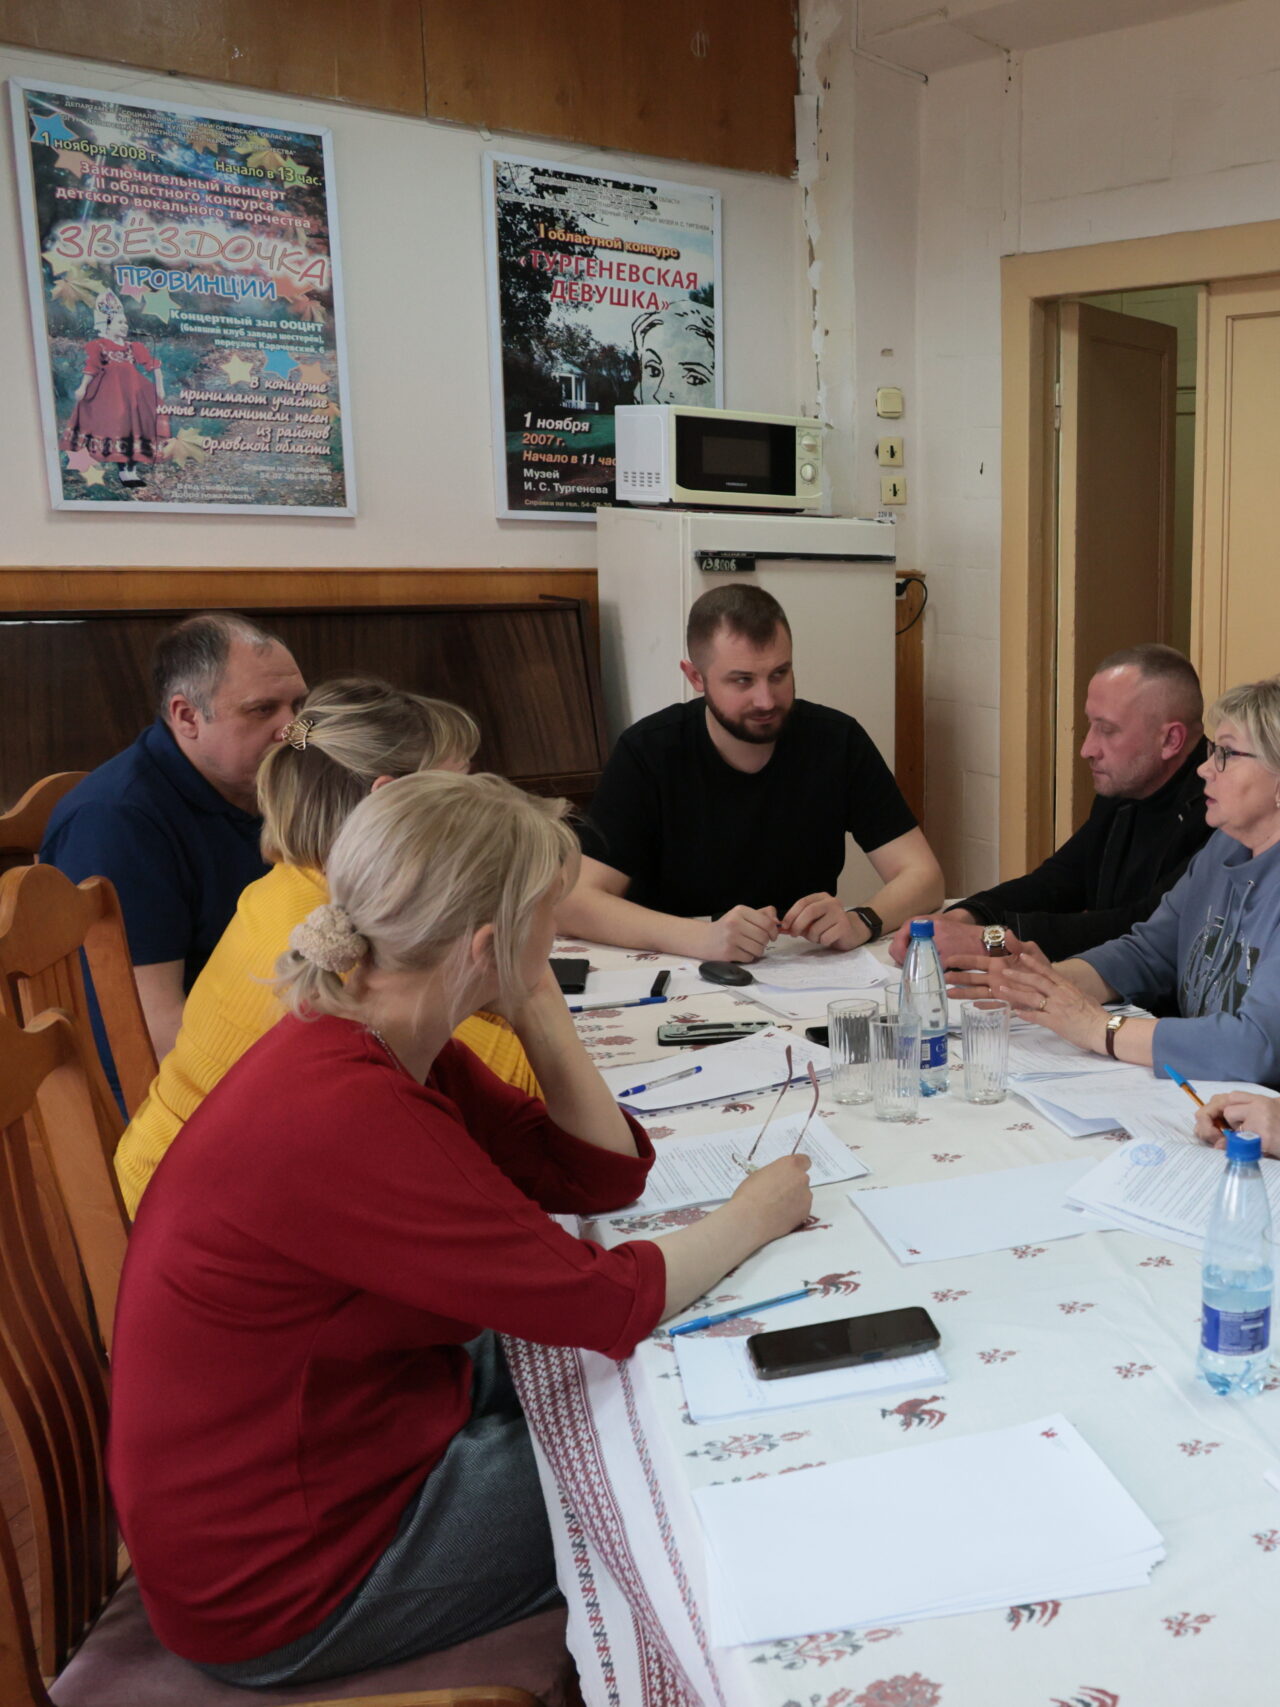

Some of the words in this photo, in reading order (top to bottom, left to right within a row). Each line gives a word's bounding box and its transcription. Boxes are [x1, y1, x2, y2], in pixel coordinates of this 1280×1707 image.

[41, 132, 50, 147] 1
[54, 139, 107, 156] ноября
[110, 143, 147, 161] 2008
[151, 152, 161, 163] г.
[81, 161, 220, 192] Заключительный
[224, 183, 287, 201] концерт
[216, 160, 264, 178] Начало
[267, 170, 275, 179] в
[278, 167, 295, 182] 13
[299, 173, 323, 187] час.
[96, 177, 105, 189] II
[110, 180, 201, 201] областного
[205, 194, 275, 212] конкурса
[55, 187, 129, 206] детского
[133, 198, 225, 218] вокального
[228, 209, 311, 229] творчества
[56, 217, 328, 286] ЗВЁЗДОЧКА
[538, 222, 546, 239] I
[548, 227, 623, 250] областной
[624, 241, 681, 260] конкурс
[518, 249, 699, 291] «ТУРГЕНЕВСКАЯ
[115, 265, 277, 300] ПРОВИНЦИИ
[549, 278, 670, 312] ДЕВУШКА»
[170, 310, 253, 326] Концертный
[256, 318, 277, 328] зал
[280, 319, 324, 332] ООЦНТ
[180, 322, 221, 335] (бывший
[223, 326, 246, 337] клуб
[247, 331, 277, 340] завода
[214, 338, 257, 349] переулок
[250, 377, 260, 389] В
[264, 379, 329, 394] концерте
[179, 388, 267, 405] принимают
[272, 395, 328, 411] участие
[156, 404, 195, 416] юные
[200, 408, 290, 422] исполнители
[294, 413, 329, 424] песен
[523, 411, 533, 428] 1
[536, 417, 590, 434] ноября
[202, 436, 270, 454] Орловской
[275, 439, 331, 455] области
[256, 426, 272, 444] из
[276, 426, 332, 440] районов
[522, 432, 555, 446] 2007
[556, 437, 566, 447] г.
[522, 449, 569, 464] Начало
[570, 455, 578, 464] в
[581, 453, 596, 465] 11
[523, 468, 560, 480] Музей
[523, 481, 536, 491] И.
[538, 482, 551, 492] С.
[552, 482, 609, 494] Тургенева
